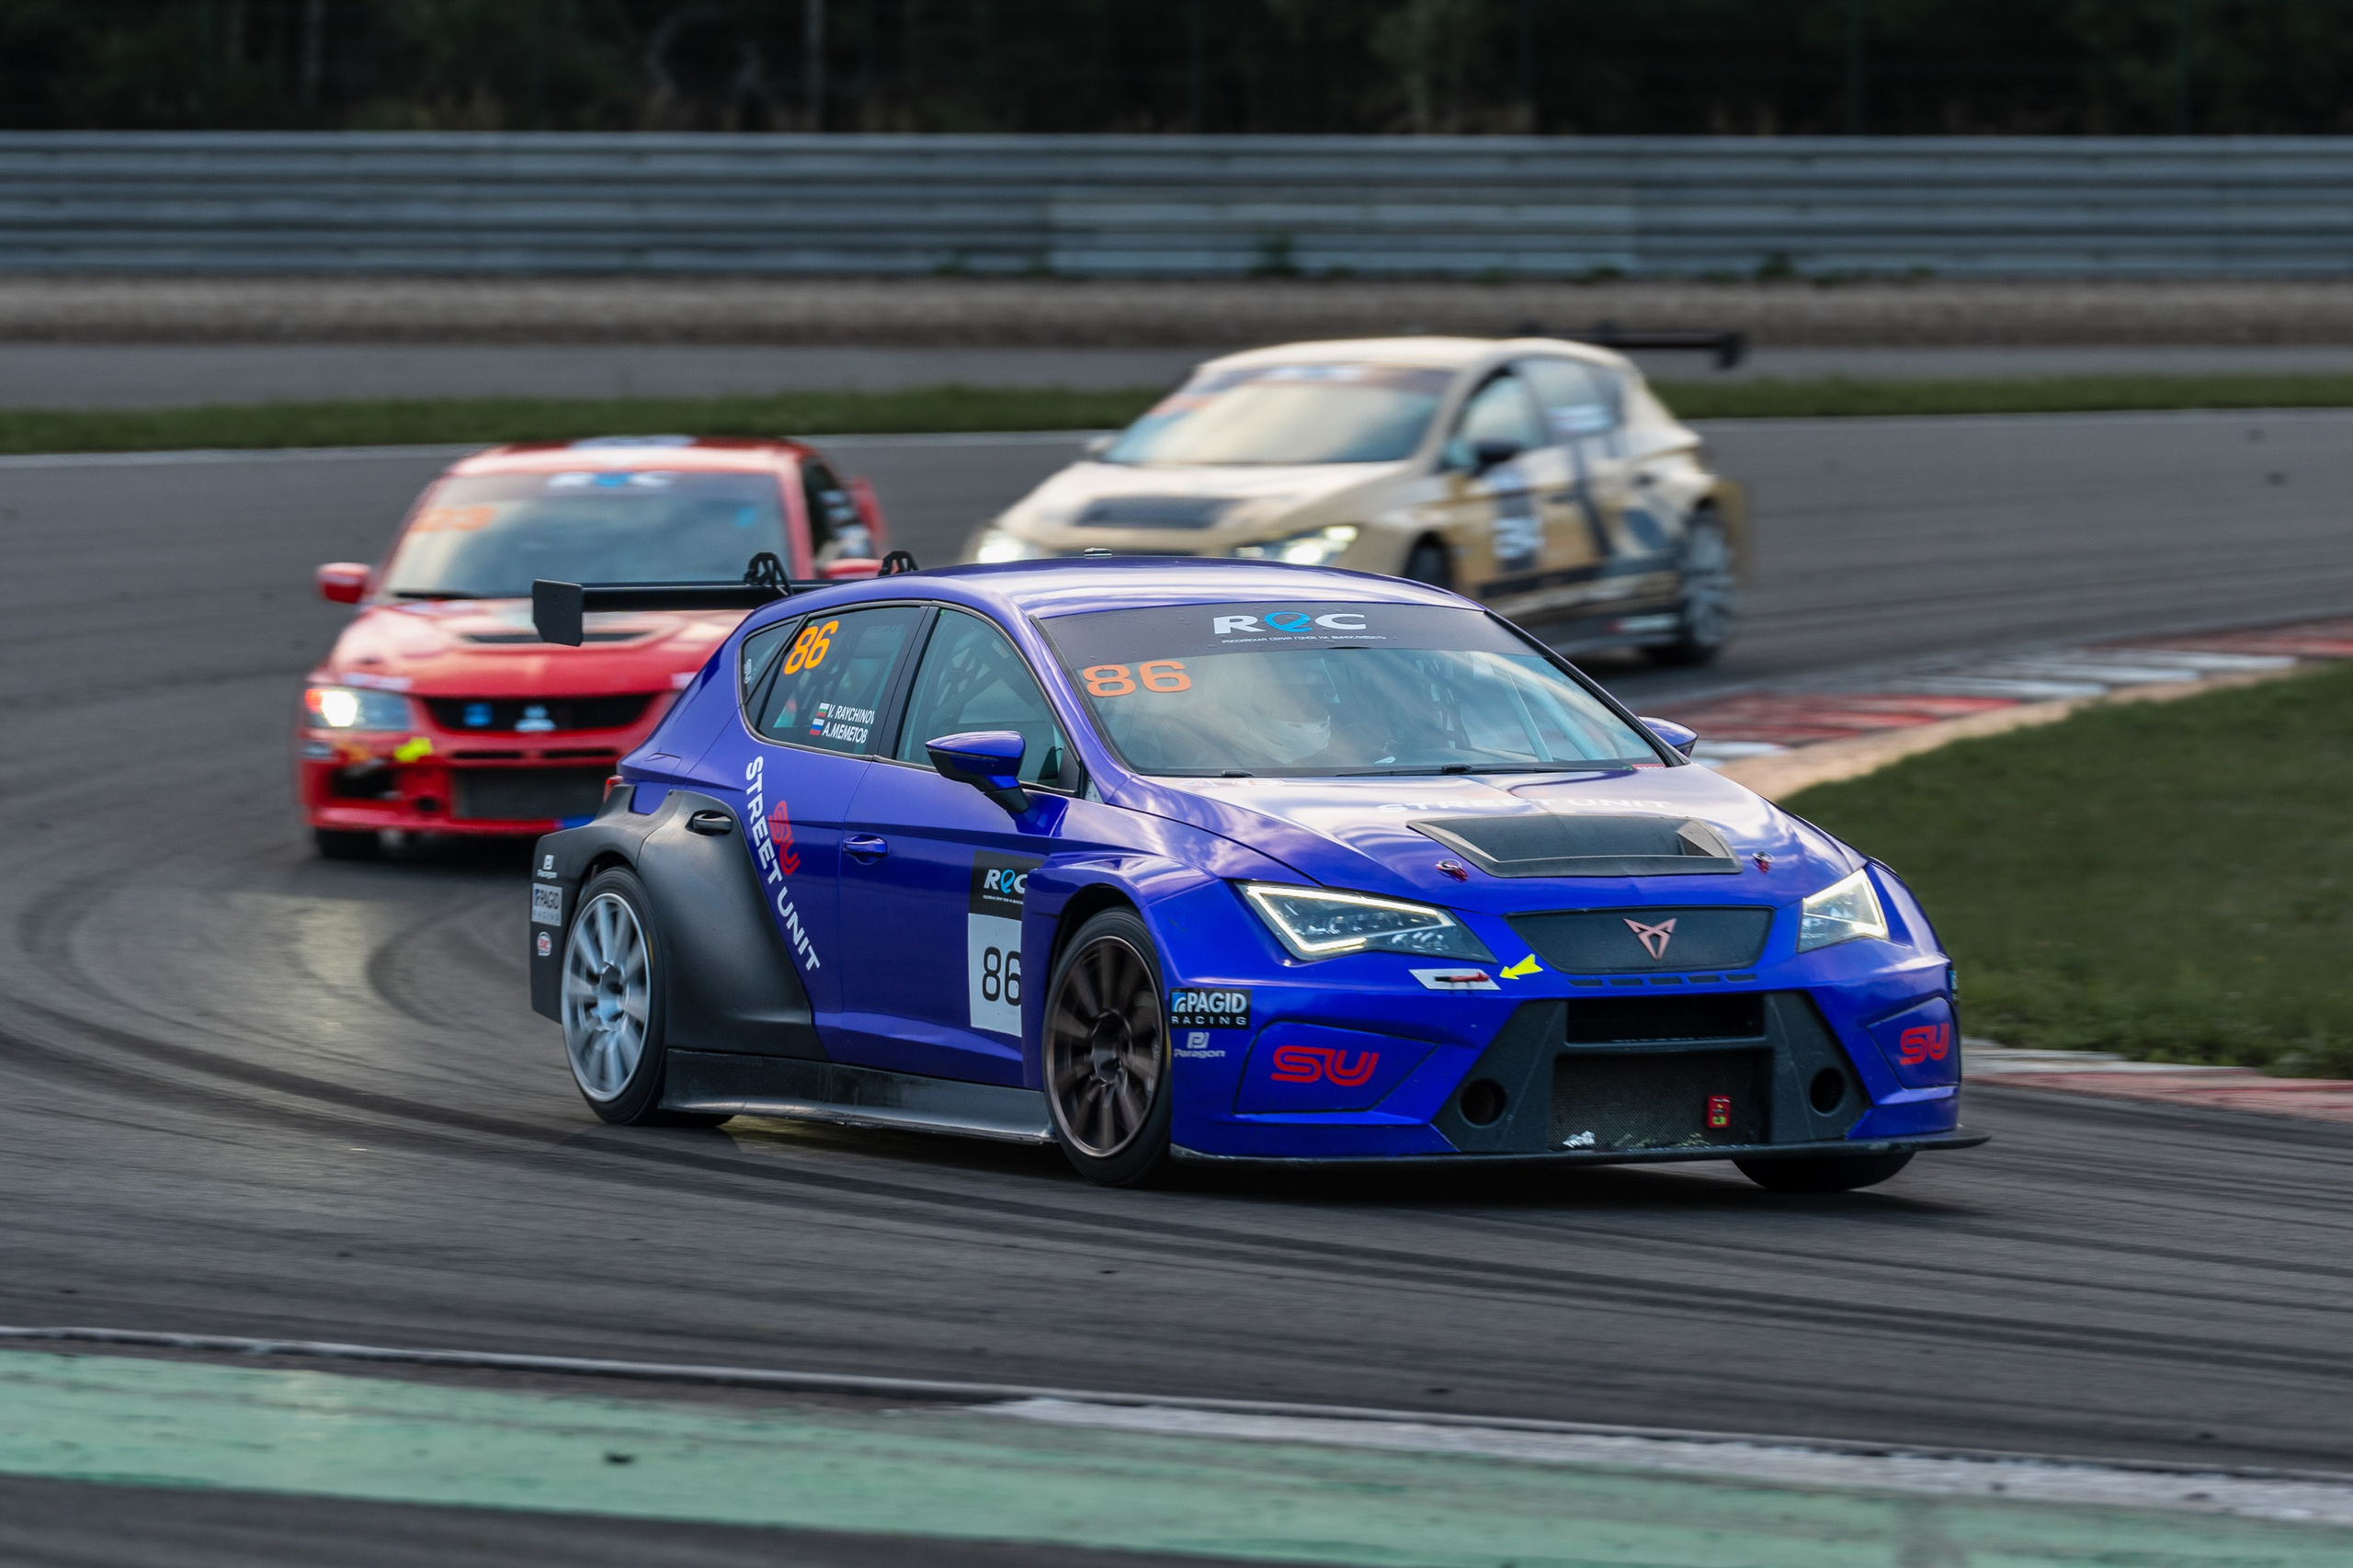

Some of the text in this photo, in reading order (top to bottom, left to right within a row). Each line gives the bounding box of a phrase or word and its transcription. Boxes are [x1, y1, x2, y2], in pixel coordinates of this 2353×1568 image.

[783, 619, 840, 676] 86
[1082, 660, 1192, 697] 86
[745, 756, 821, 971] STREET UNIT
[982, 946, 1021, 1006] 86
[1171, 1016, 1247, 1026] RACING
[1187, 991, 1247, 1014] PAGID
[1173, 1049, 1225, 1059] Paragon
[1898, 1022, 1949, 1065] SU
[1270, 1044, 1381, 1087] SU
